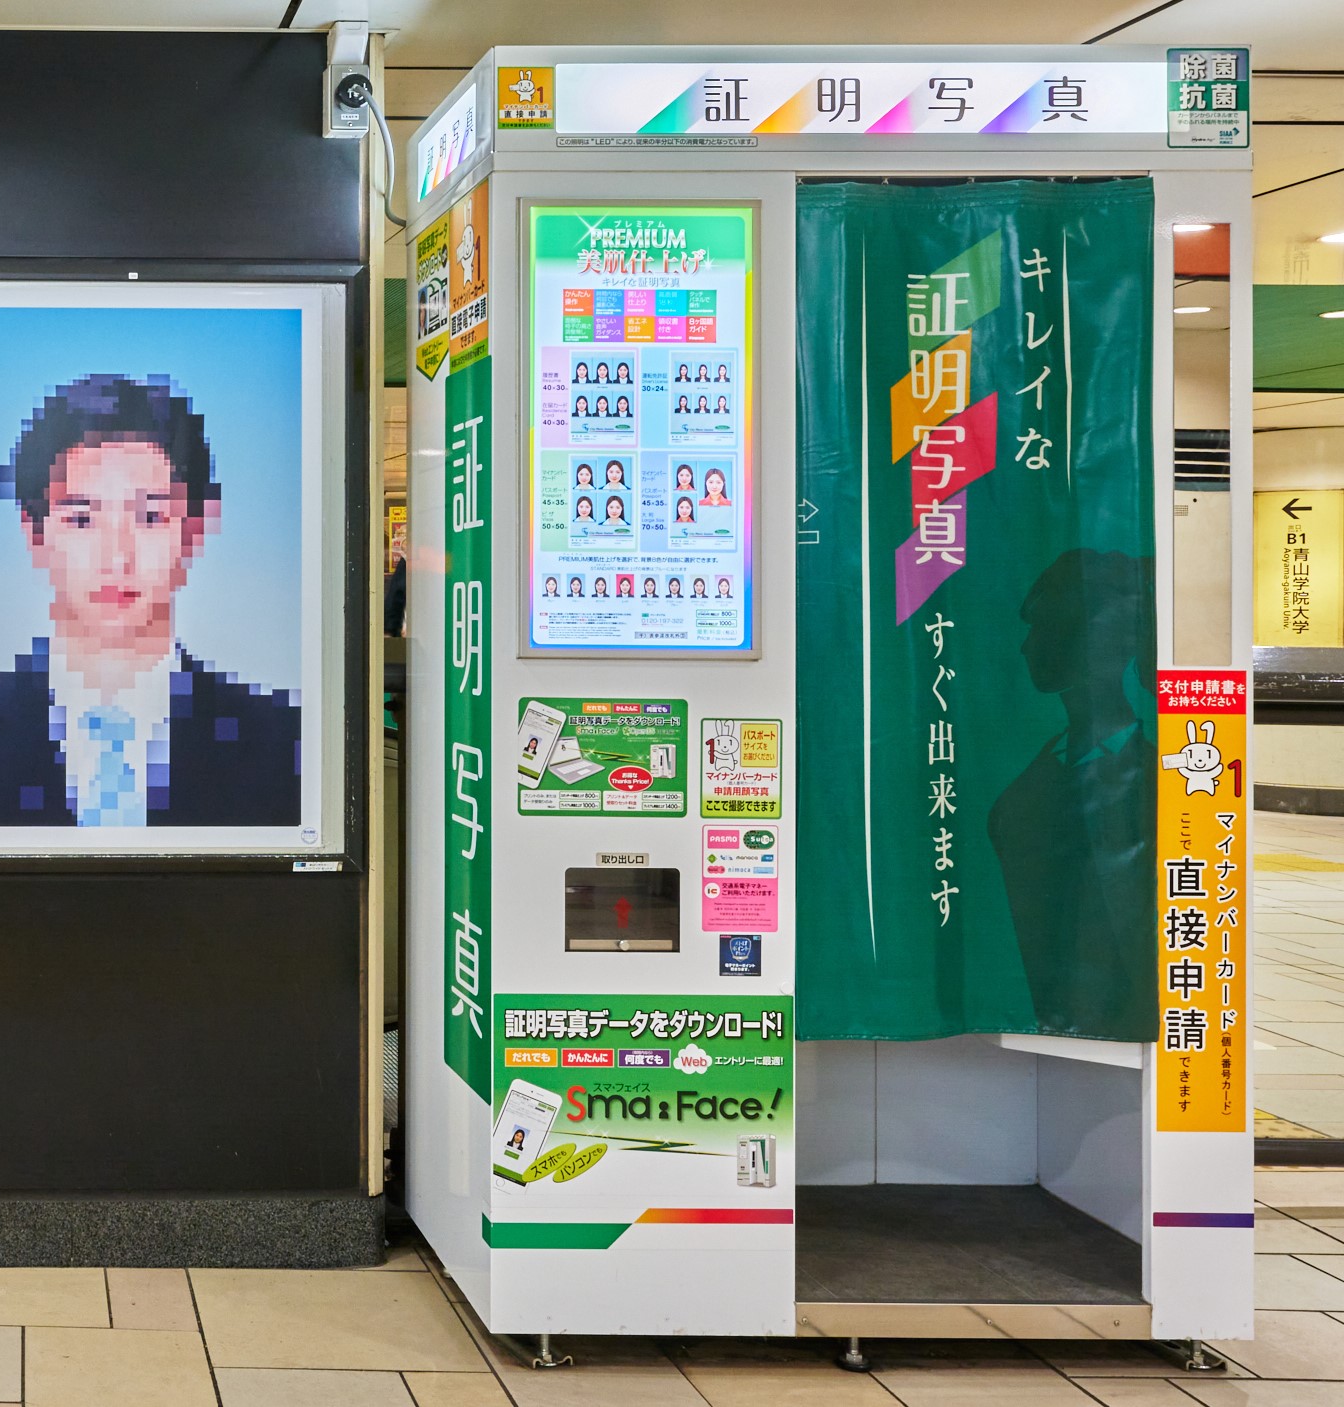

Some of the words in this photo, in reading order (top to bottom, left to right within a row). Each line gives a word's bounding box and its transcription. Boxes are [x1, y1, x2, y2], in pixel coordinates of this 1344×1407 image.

[1179, 54, 1239, 80] 除菌
[703, 76, 1088, 122] 証明写真
[1179, 83, 1238, 110] 抗菌
[427, 106, 474, 175] 証明写真
[614, 220, 665, 228] プレミアム
[590, 228, 686, 249] PREMIUM
[576, 249, 706, 275] 美肌仕上げ
[602, 278, 680, 288] キレイな証明写真
[1015, 248, 1053, 470] キレイな
[906, 272, 970, 565] 証明写真
[1287, 533, 1306, 544] B1
[1292, 548, 1309, 634] 青山学院大学
[1159, 680, 1246, 695] 交付申請書を
[1168, 696, 1237, 707] お持ちください
[452, 415, 483, 1039] 証明写真
[569, 716, 680, 726] 証明写真データをダウンロード!
[743, 730, 776, 740] パスポート
[743, 753, 775, 761] お選びください
[705, 772, 778, 781] マイナンバーカード
[924, 613, 960, 928] すぐ出来ます
[714, 787, 769, 796] 申請用顔写真
[706, 800, 777, 812] ここで撮影できます
[601, 855, 645, 864] 取り出し口
[1216, 812, 1237, 1031] マイナンバーカード
[1166, 857, 1206, 1050] 直接申請
[504, 1009, 783, 1039] 証明写真データをダウンロード!
[512, 1052, 551, 1063] だれでも
[567, 1052, 609, 1063] かんたんに
[624, 1053, 664, 1065] 何度でも
[681, 1056, 708, 1068] Web
[714, 1056, 784, 1066] エントリーに最適!
[1179, 1057, 1191, 1112] できます
[677, 1087, 783, 1122] Face!
[530, 1150, 567, 1178] スマホでも
[560, 1147, 603, 1180] パソコンでも
